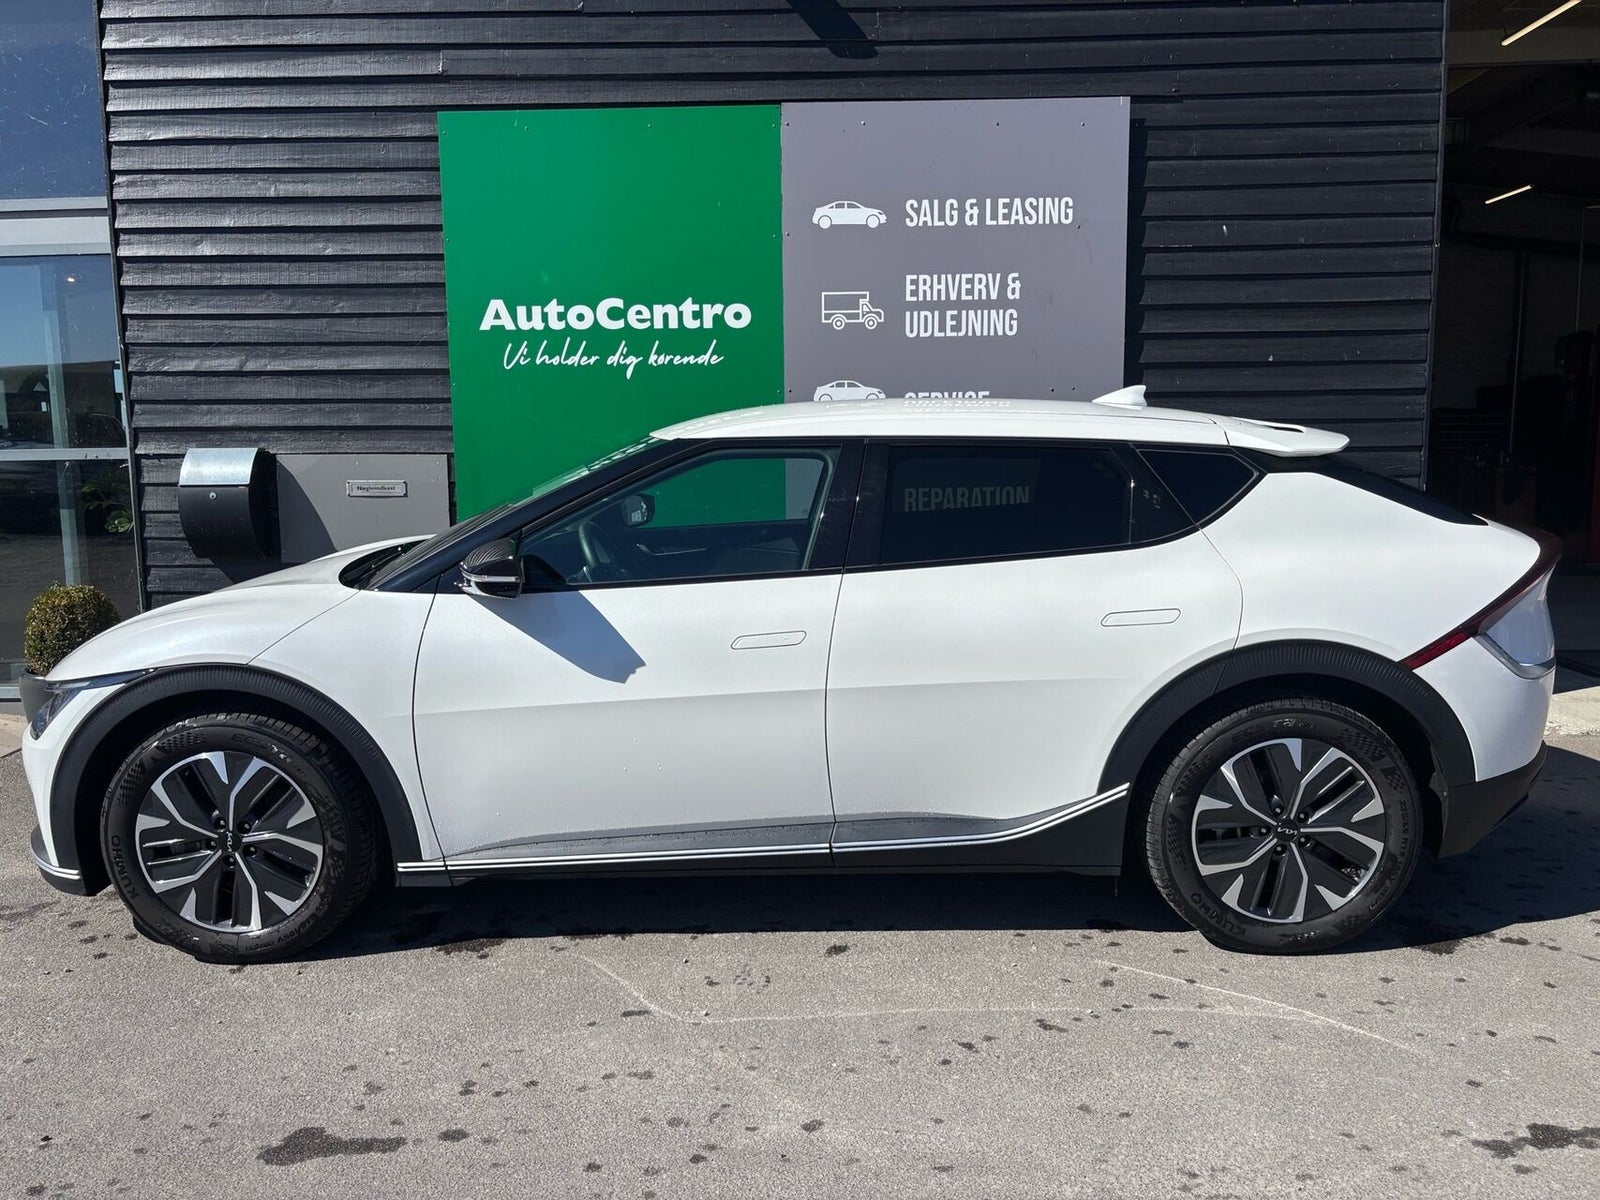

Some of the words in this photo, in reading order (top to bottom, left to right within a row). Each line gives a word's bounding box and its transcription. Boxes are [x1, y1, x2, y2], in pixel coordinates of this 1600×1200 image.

[905, 198, 959, 227] SALG
[965, 198, 980, 226] &
[985, 196, 1074, 226] LEASING
[905, 273, 1001, 301] ERHVERV
[1006, 272, 1022, 300] &
[479, 297, 752, 331] AutoCentro
[905, 308, 1018, 338] UDLEJNING
[503, 340, 530, 370] Vi
[535, 336, 600, 366] holder
[606, 340, 644, 380] dig
[904, 486, 1030, 512] REPARATION
